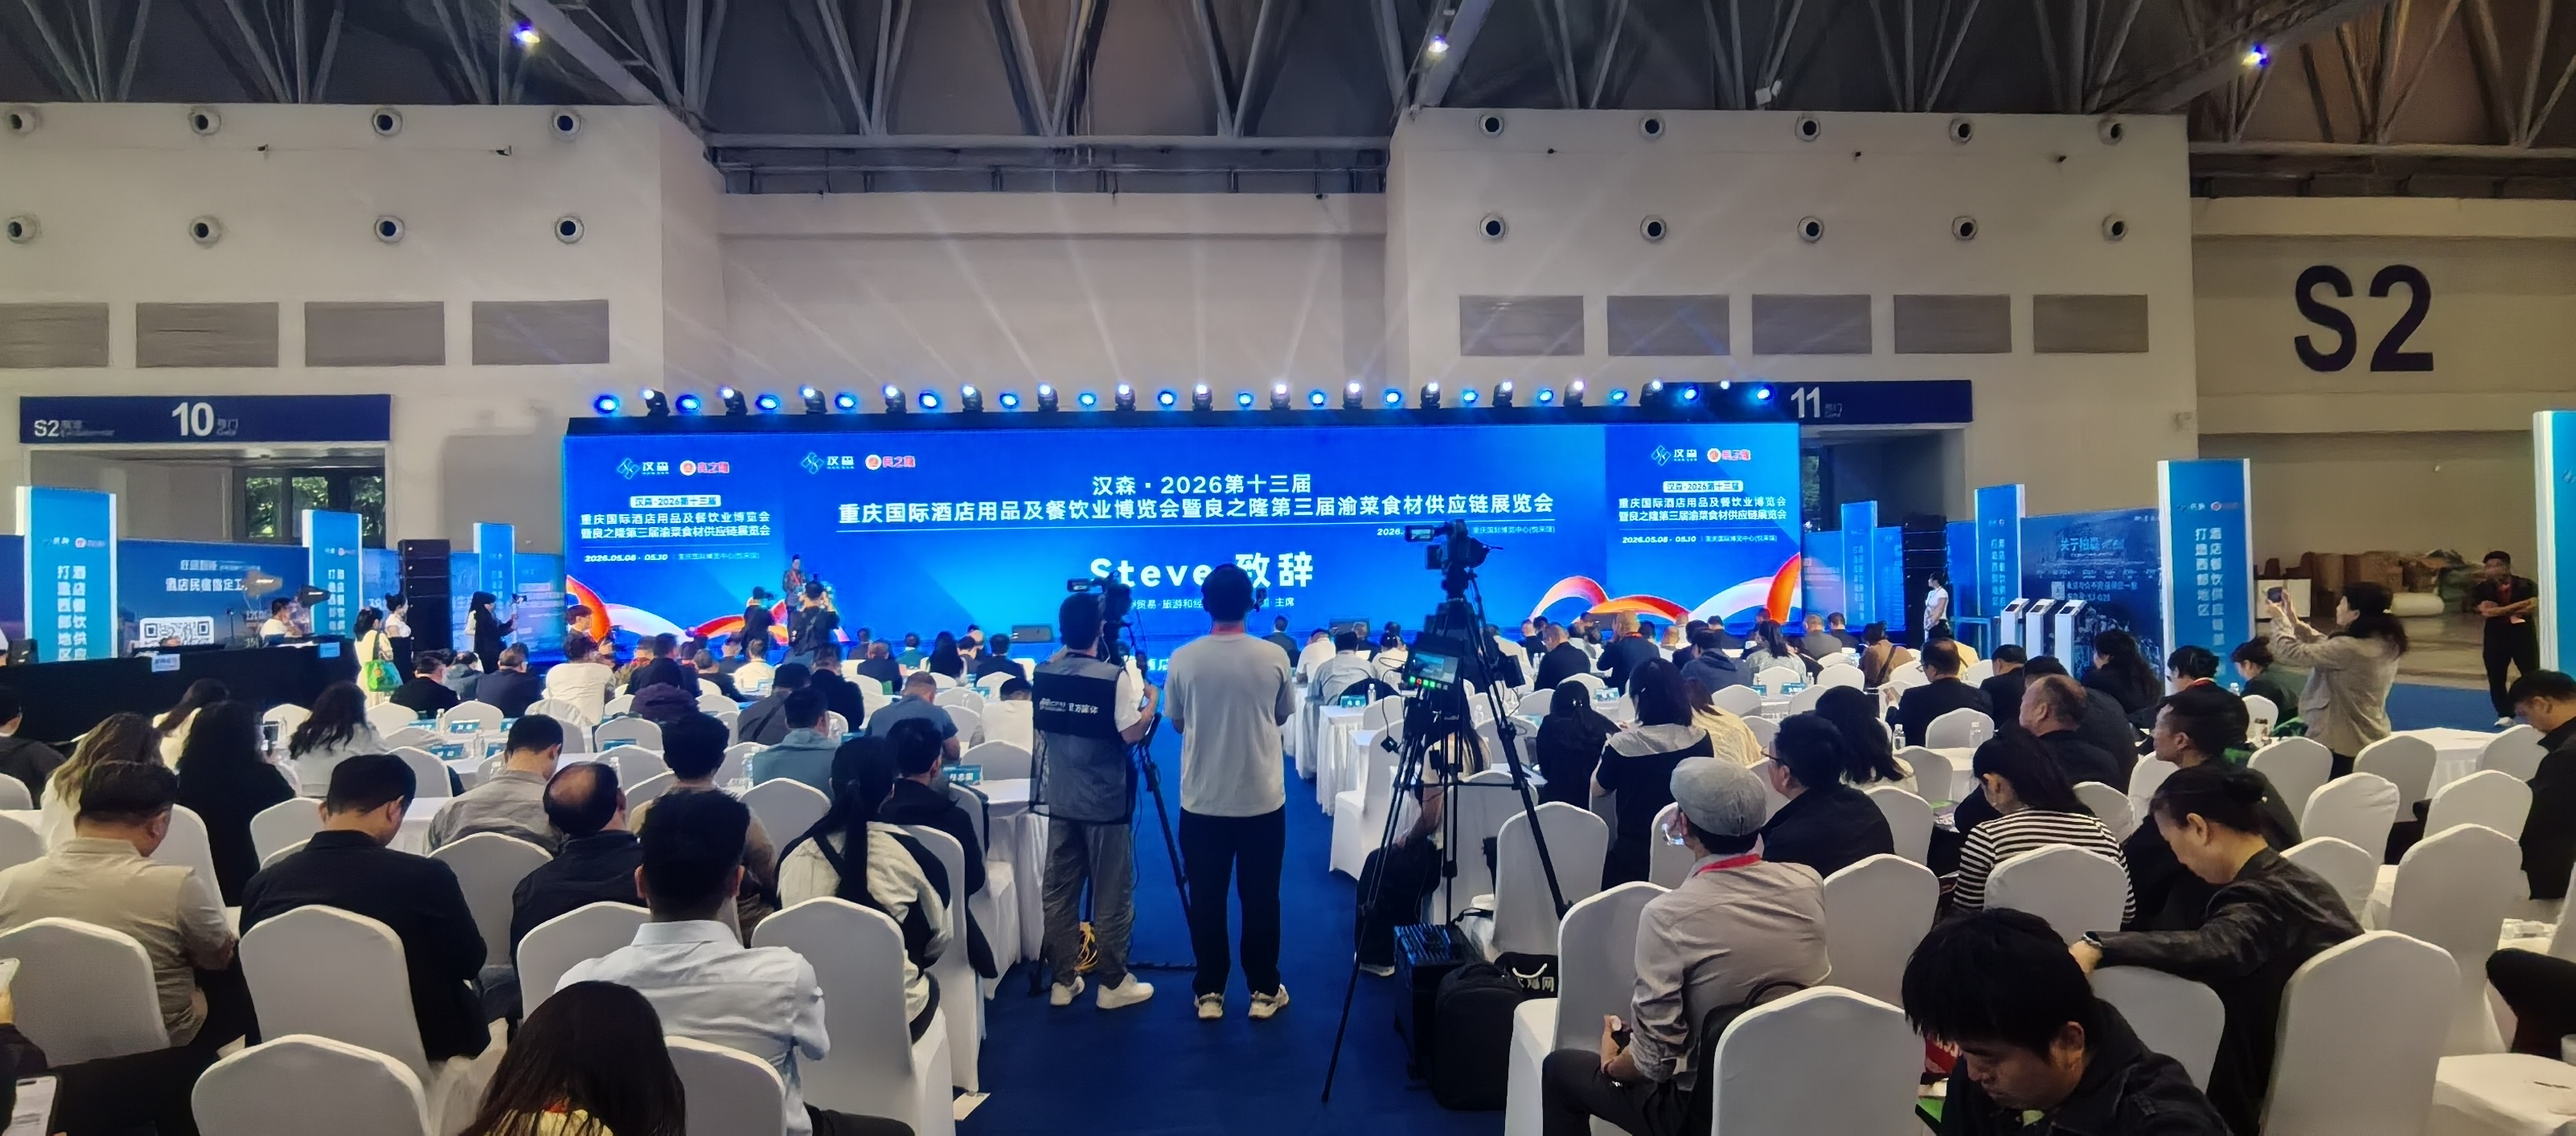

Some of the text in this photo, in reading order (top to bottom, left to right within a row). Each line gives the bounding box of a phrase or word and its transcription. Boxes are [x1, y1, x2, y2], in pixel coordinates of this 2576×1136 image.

[2294, 264, 2434, 372] S2
[1791, 387, 1820, 418] 11
[34, 419, 59, 437] S2
[171, 402, 214, 436] 10
[1092, 473, 1312, 495] 汉森·2026第十三届
[581, 511, 770, 525] 重庆国际酒店用品及餐饮业博览会
[838, 492, 1554, 524] 重庆国际酒店用品及餐饮业博览会暨良之隆第三届渝菜食材供应链展览会
[1619, 496, 1787, 509] 重庆国际酒店用品及餐饮业博览会
[1234, 551, 1313, 589] 致辞
